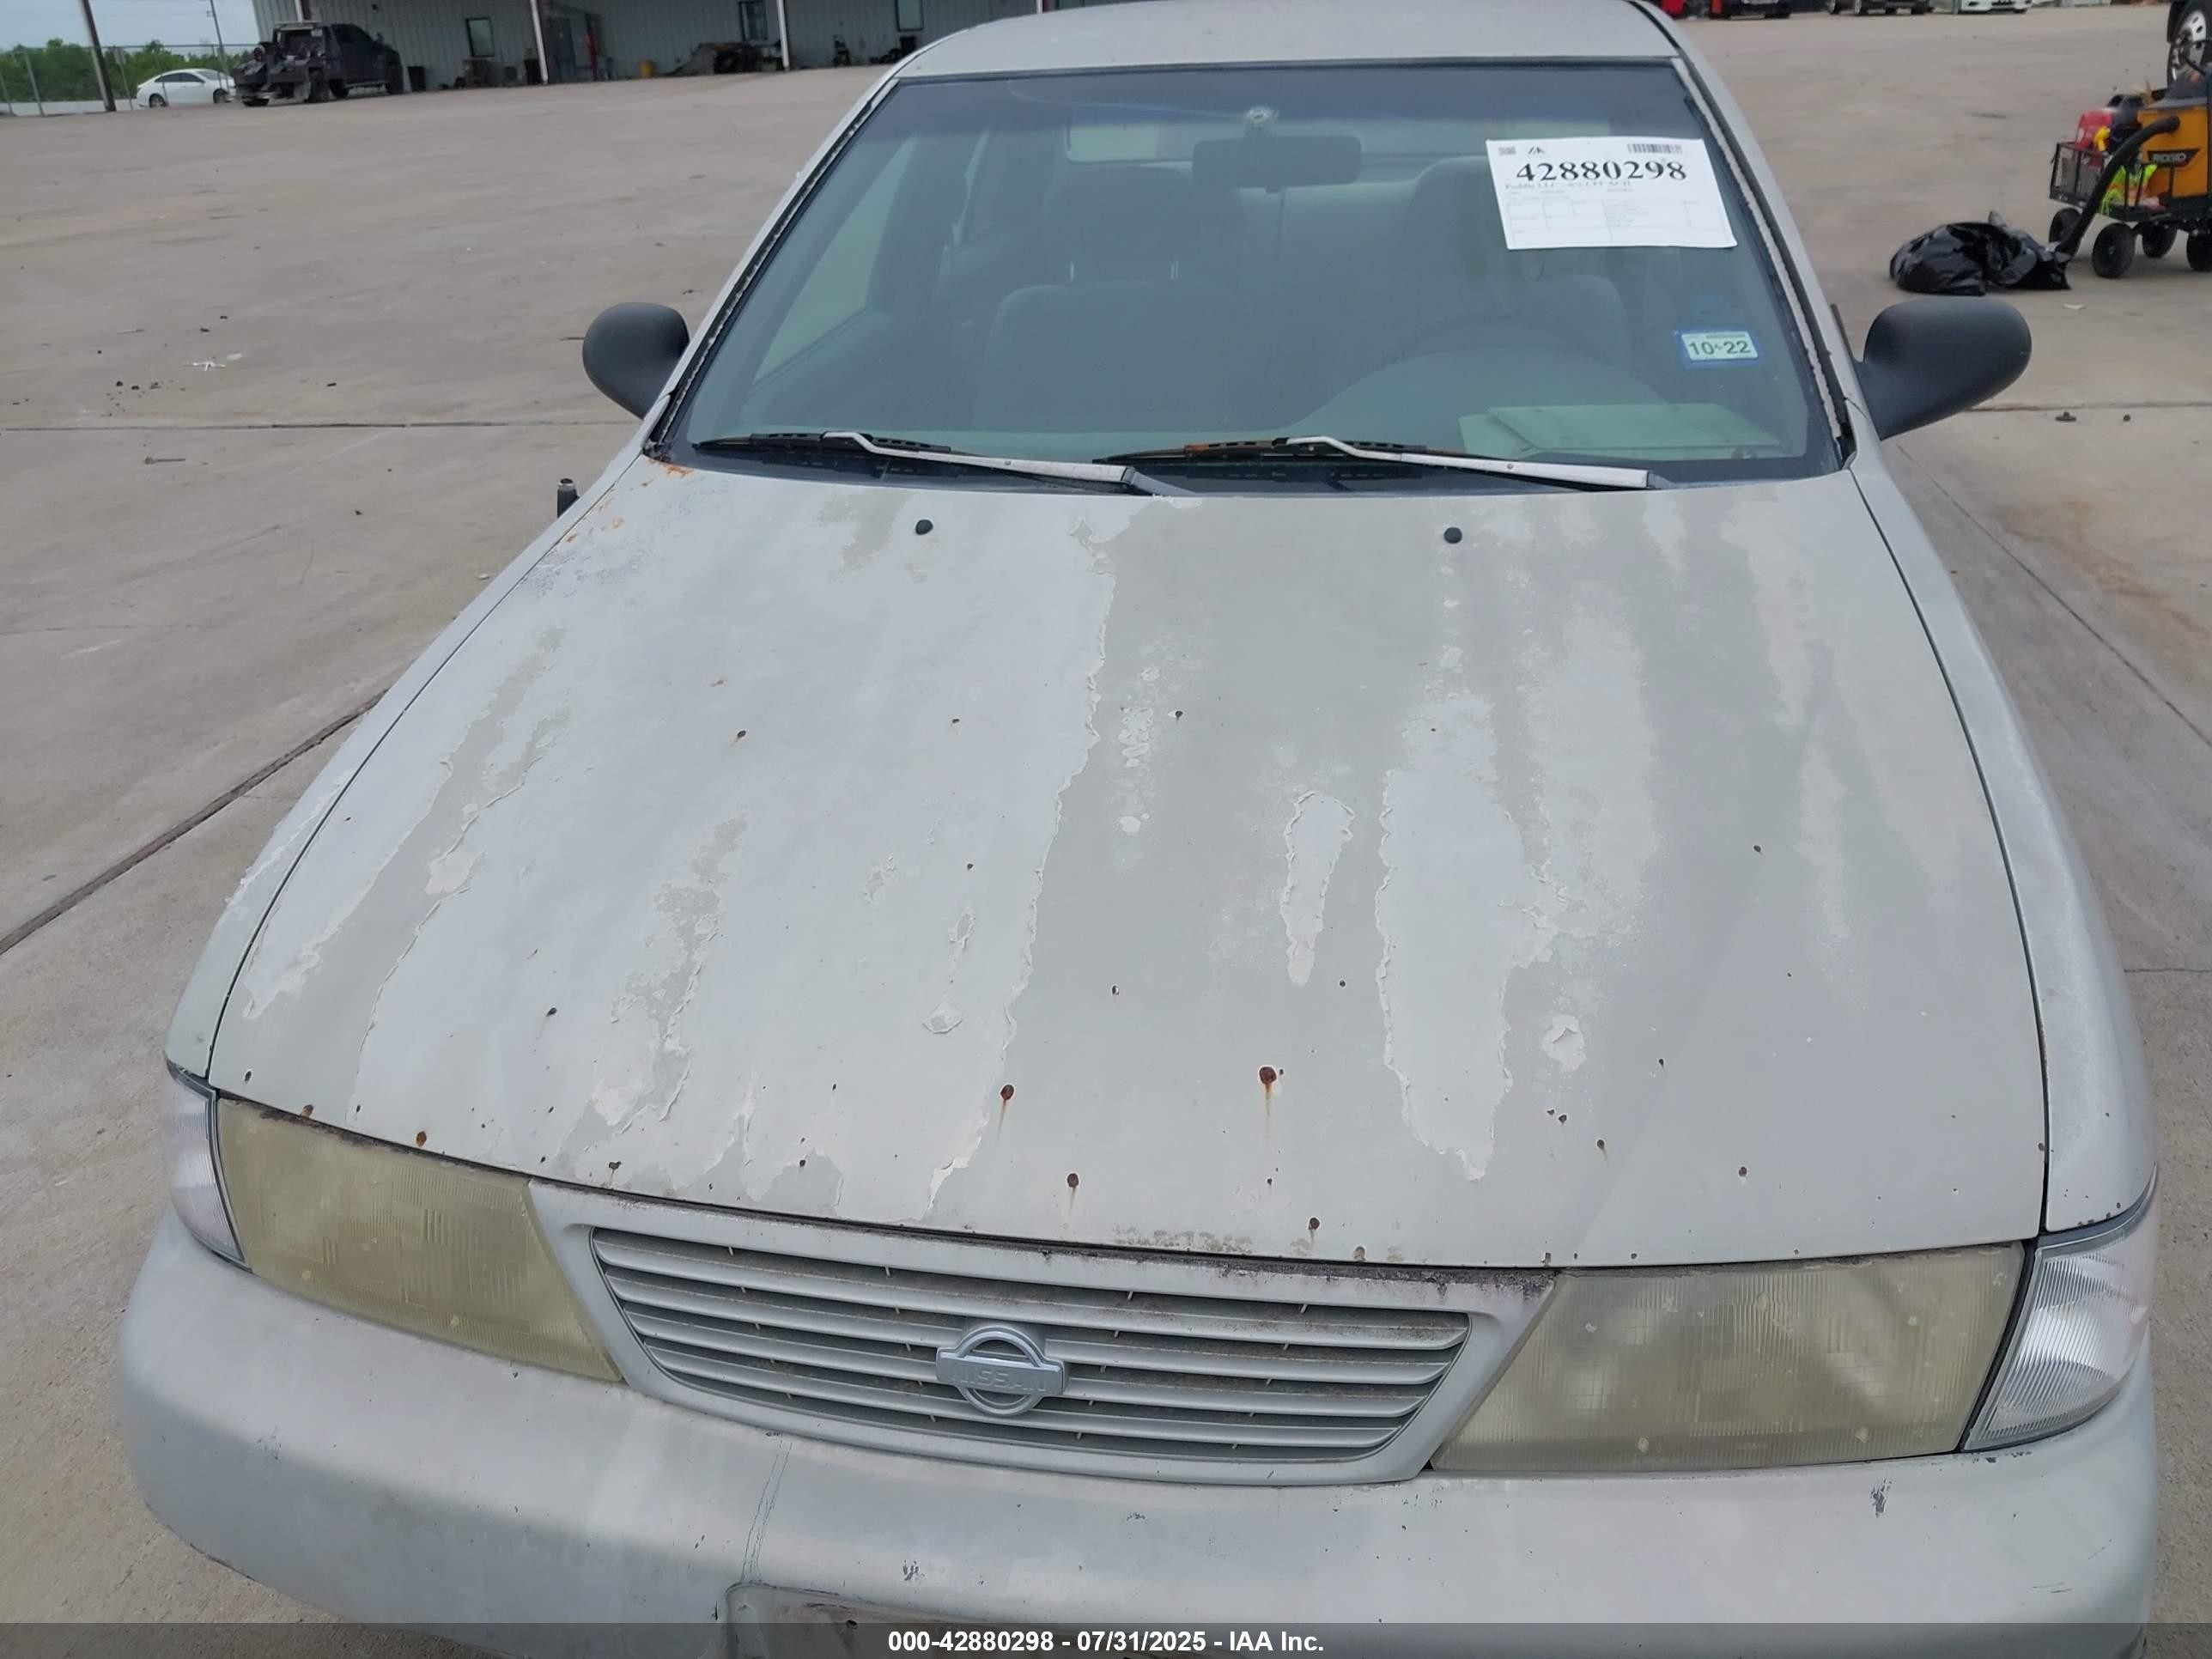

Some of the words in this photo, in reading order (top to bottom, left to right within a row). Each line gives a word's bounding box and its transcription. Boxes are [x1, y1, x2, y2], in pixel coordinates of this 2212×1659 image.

[1516, 161, 1686, 181] 42880298
[1689, 341, 1715, 356] 10
[1723, 340, 1752, 355] 22
